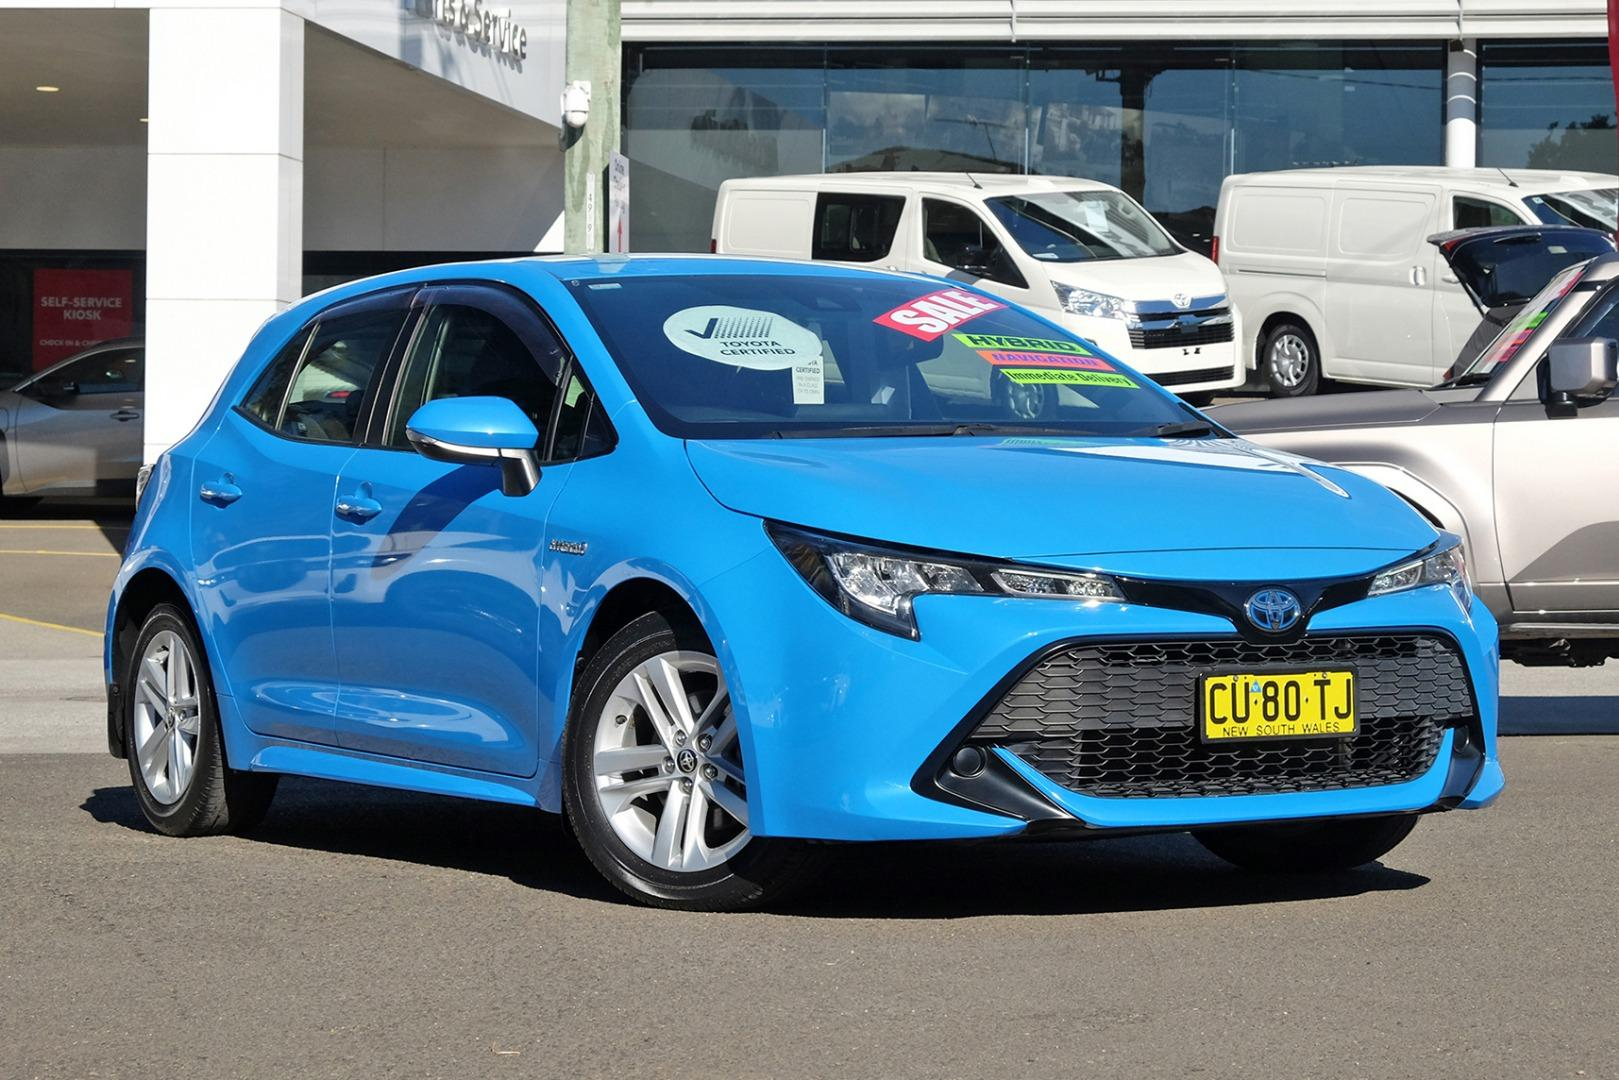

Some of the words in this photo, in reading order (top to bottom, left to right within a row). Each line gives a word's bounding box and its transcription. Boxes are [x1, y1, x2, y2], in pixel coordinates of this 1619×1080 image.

[475, 0, 527, 59] Service
[41, 296, 122, 308] SELF-SERVICE
[63, 310, 101, 320] KIOSK
[890, 291, 999, 333] SALE
[720, 340, 781, 348] TOYOTA
[966, 335, 1076, 351] HYBRID
[720, 348, 796, 356] CERTIFIED
[992, 353, 1097, 366] NAVIGATION
[795, 366, 821, 375] CERTIFIED
[1006, 371, 1075, 382] Immediate
[1076, 372, 1132, 387] Delivery
[1223, 726, 1248, 737] NEW
[1256, 724, 1295, 736] SOUTH
[1302, 722, 1340, 734] WALES
